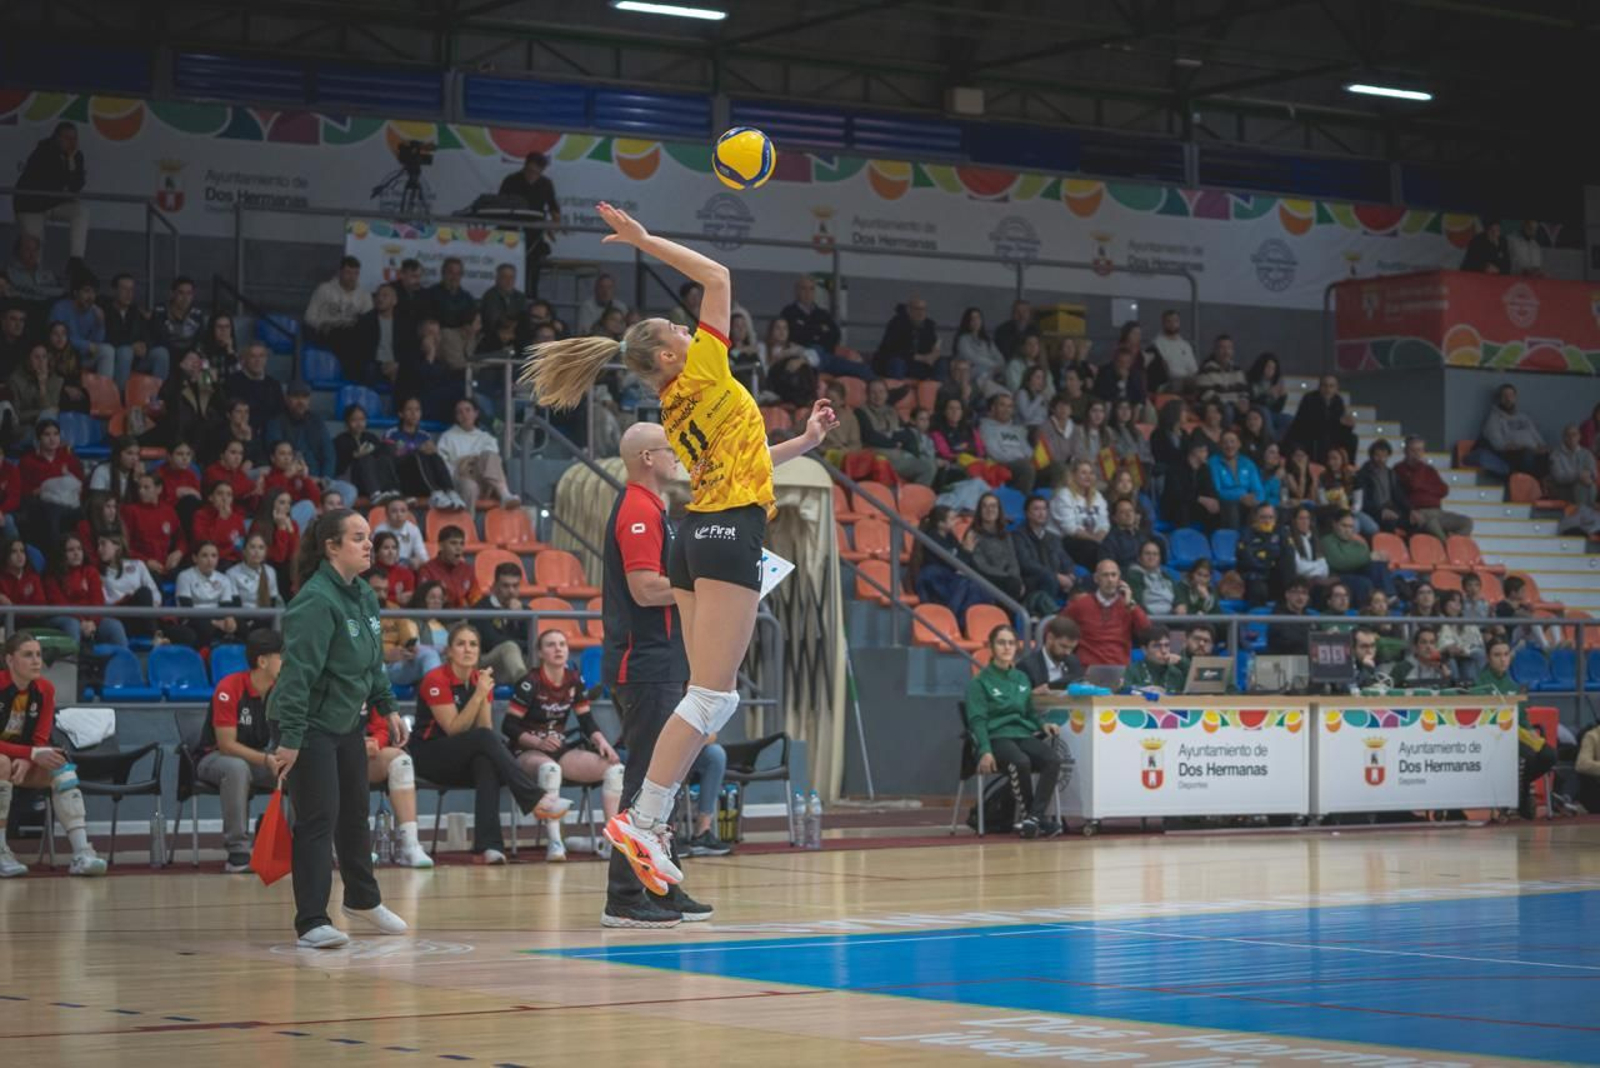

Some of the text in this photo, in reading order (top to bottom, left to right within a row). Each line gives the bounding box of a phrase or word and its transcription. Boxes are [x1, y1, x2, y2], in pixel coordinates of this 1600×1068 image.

[205, 187, 233, 201] Dos
[679, 419, 709, 463] 11
[1178, 743, 1269, 760] Ayuntamiento de
[1399, 741, 1482, 757] Ayuntamiento de
[1179, 762, 1269, 777] Dos Hermanas
[1399, 760, 1482, 773] Dos Hermanas
[960, 1016, 1153, 1038] Dos
